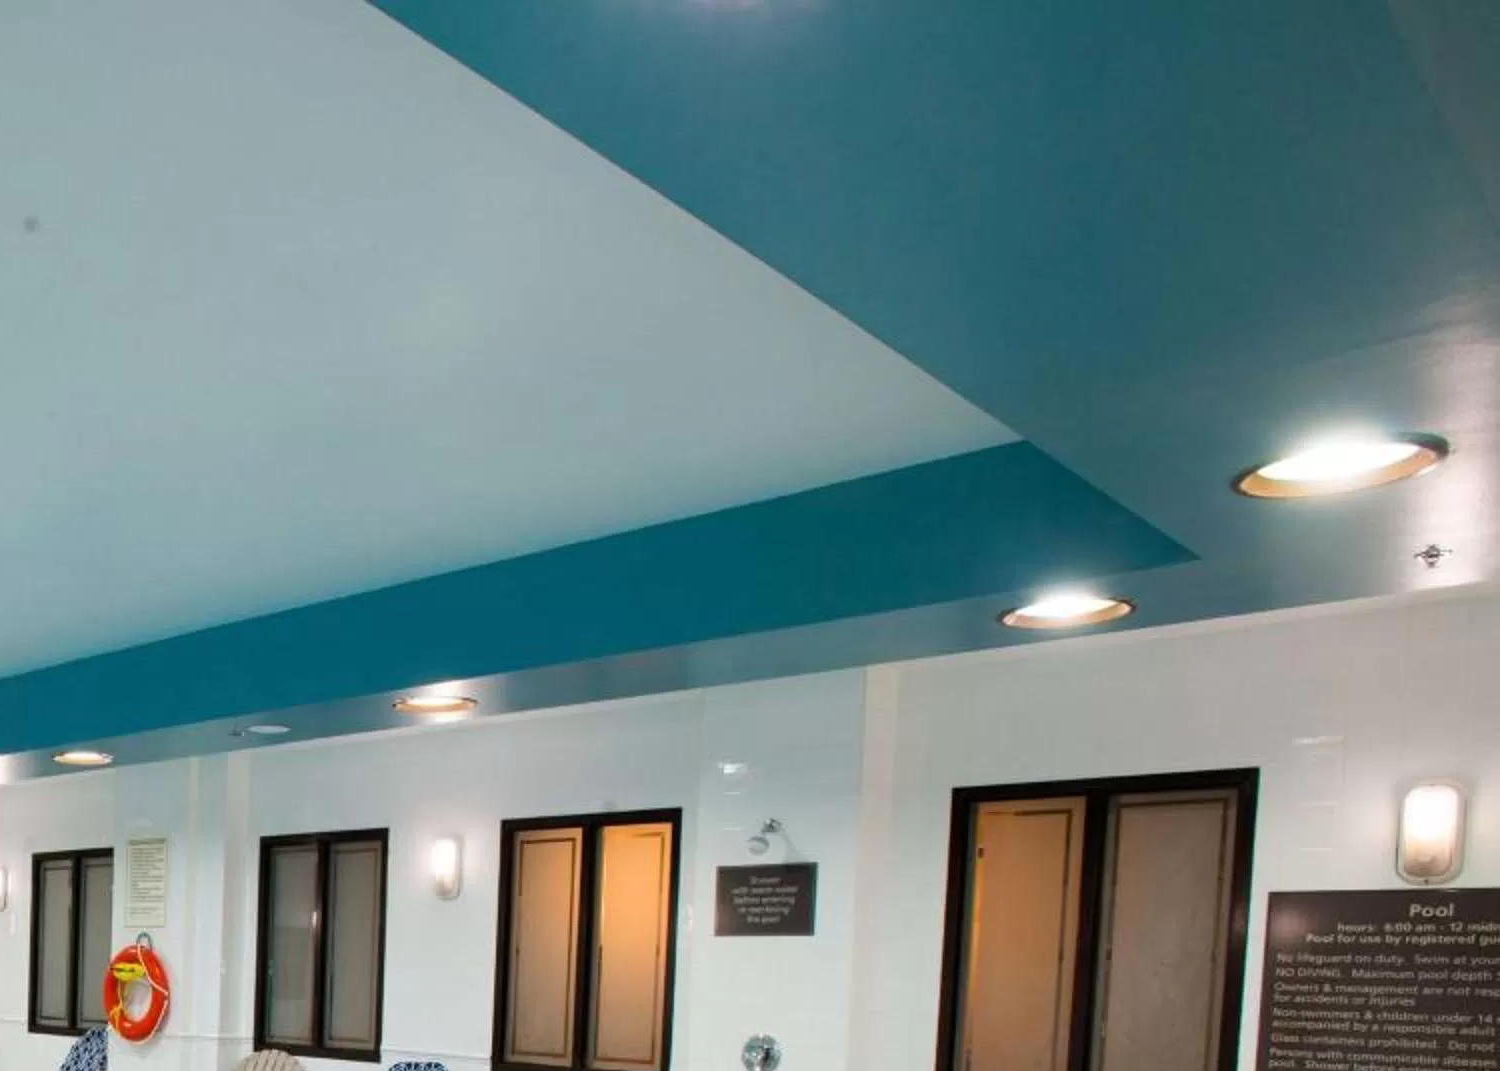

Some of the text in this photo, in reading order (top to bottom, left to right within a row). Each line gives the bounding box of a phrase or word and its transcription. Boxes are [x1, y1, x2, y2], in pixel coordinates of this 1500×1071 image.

[1409, 903, 1455, 917] Pool
[1450, 921, 1463, 932] 12
[1306, 933, 1335, 943] Pool
[1337, 932, 1356, 944] for
[1359, 935, 1381, 944] use
[1385, 934, 1402, 946] by
[1405, 934, 1476, 947] registered
[1354, 955, 1372, 963] on
[1414, 953, 1450, 965] Swim
[1452, 954, 1467, 965] at
[1418, 969, 1449, 982] pool
[1335, 984, 1419, 997] management
[1447, 986, 1472, 997] not
[1431, 1011, 1473, 1023] under
